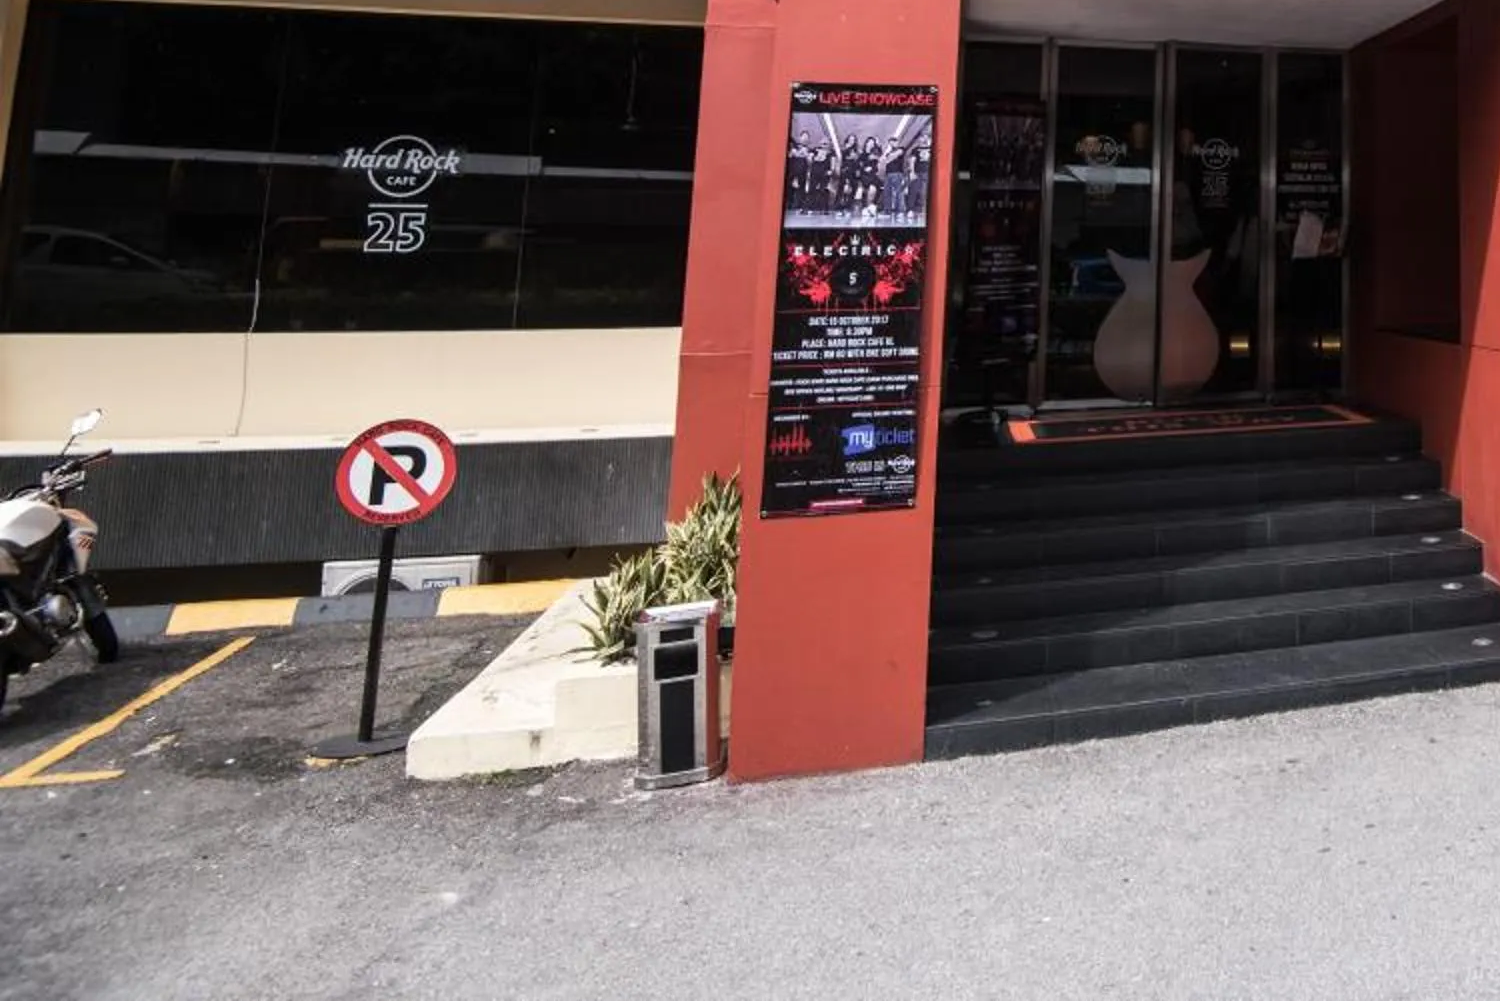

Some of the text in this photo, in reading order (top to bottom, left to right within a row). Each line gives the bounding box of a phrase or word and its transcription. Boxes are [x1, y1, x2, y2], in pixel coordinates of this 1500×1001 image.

[343, 147, 460, 174] Hard Rock
[386, 176, 417, 186] CAFE
[363, 211, 428, 253] 25
